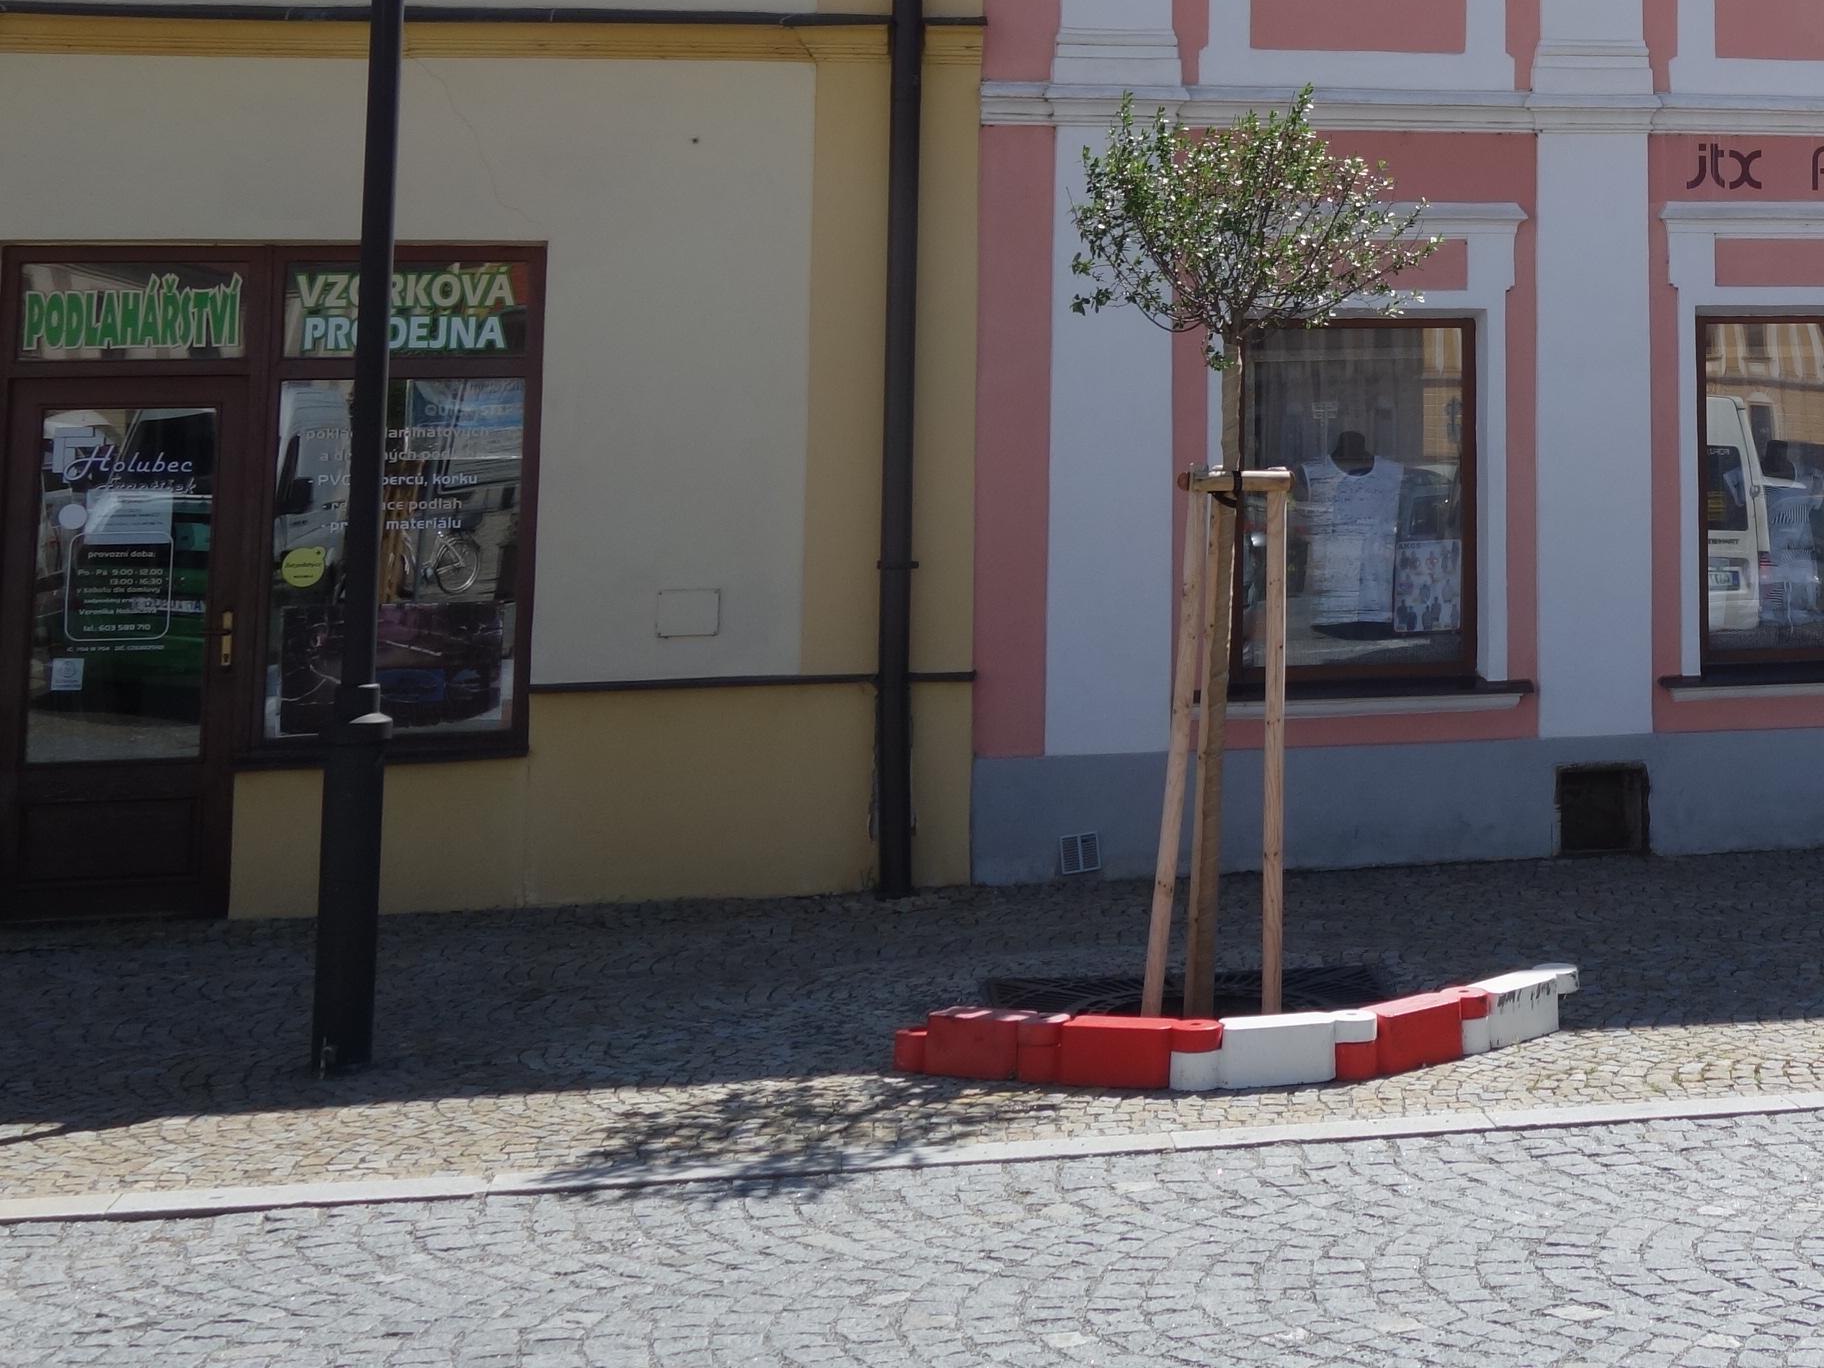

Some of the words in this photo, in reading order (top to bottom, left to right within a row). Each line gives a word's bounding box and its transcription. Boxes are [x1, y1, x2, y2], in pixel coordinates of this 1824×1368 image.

[1686, 143, 1762, 190] jtx
[23, 272, 243, 353] PODLAHÁŘSTVÍ
[303, 314, 506, 352] PRDEJNA
[64, 444, 194, 482] Holubec
[432, 472, 479, 486] korku
[385, 516, 461, 531] materiálu
[409, 496, 462, 514] podlah
